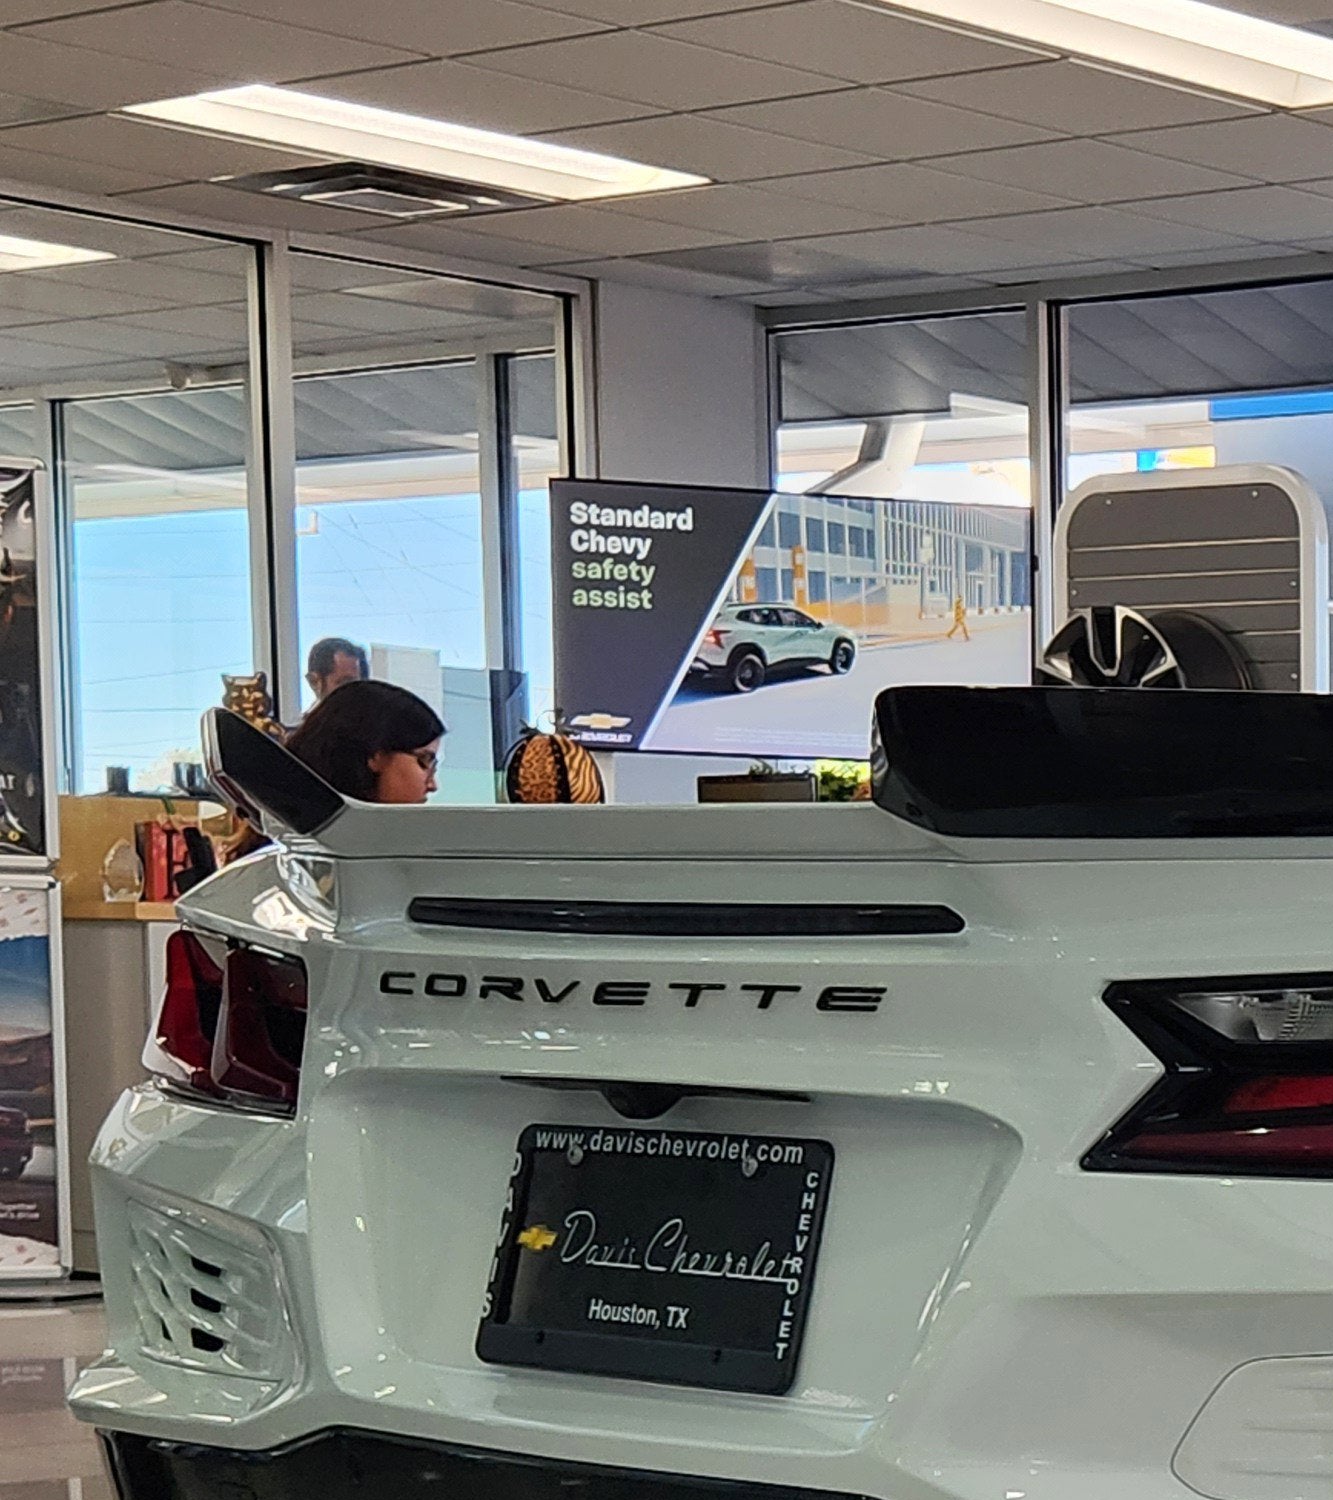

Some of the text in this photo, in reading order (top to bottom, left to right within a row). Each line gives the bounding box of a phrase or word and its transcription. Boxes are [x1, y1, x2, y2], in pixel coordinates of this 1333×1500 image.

[570, 501, 694, 531] Standard
[570, 529, 653, 560] Chevy
[572, 558, 656, 587] safety
[572, 585, 653, 609] assist
[379, 970, 888, 1012] CORVETTE
[535, 1129, 804, 1165] www.davischevrolet.com
[560, 1210, 793, 1284] Davis Chevrolet
[772, 1171, 820, 1360] CHEVROLET
[587, 1298, 690, 1329] Houston, TX
